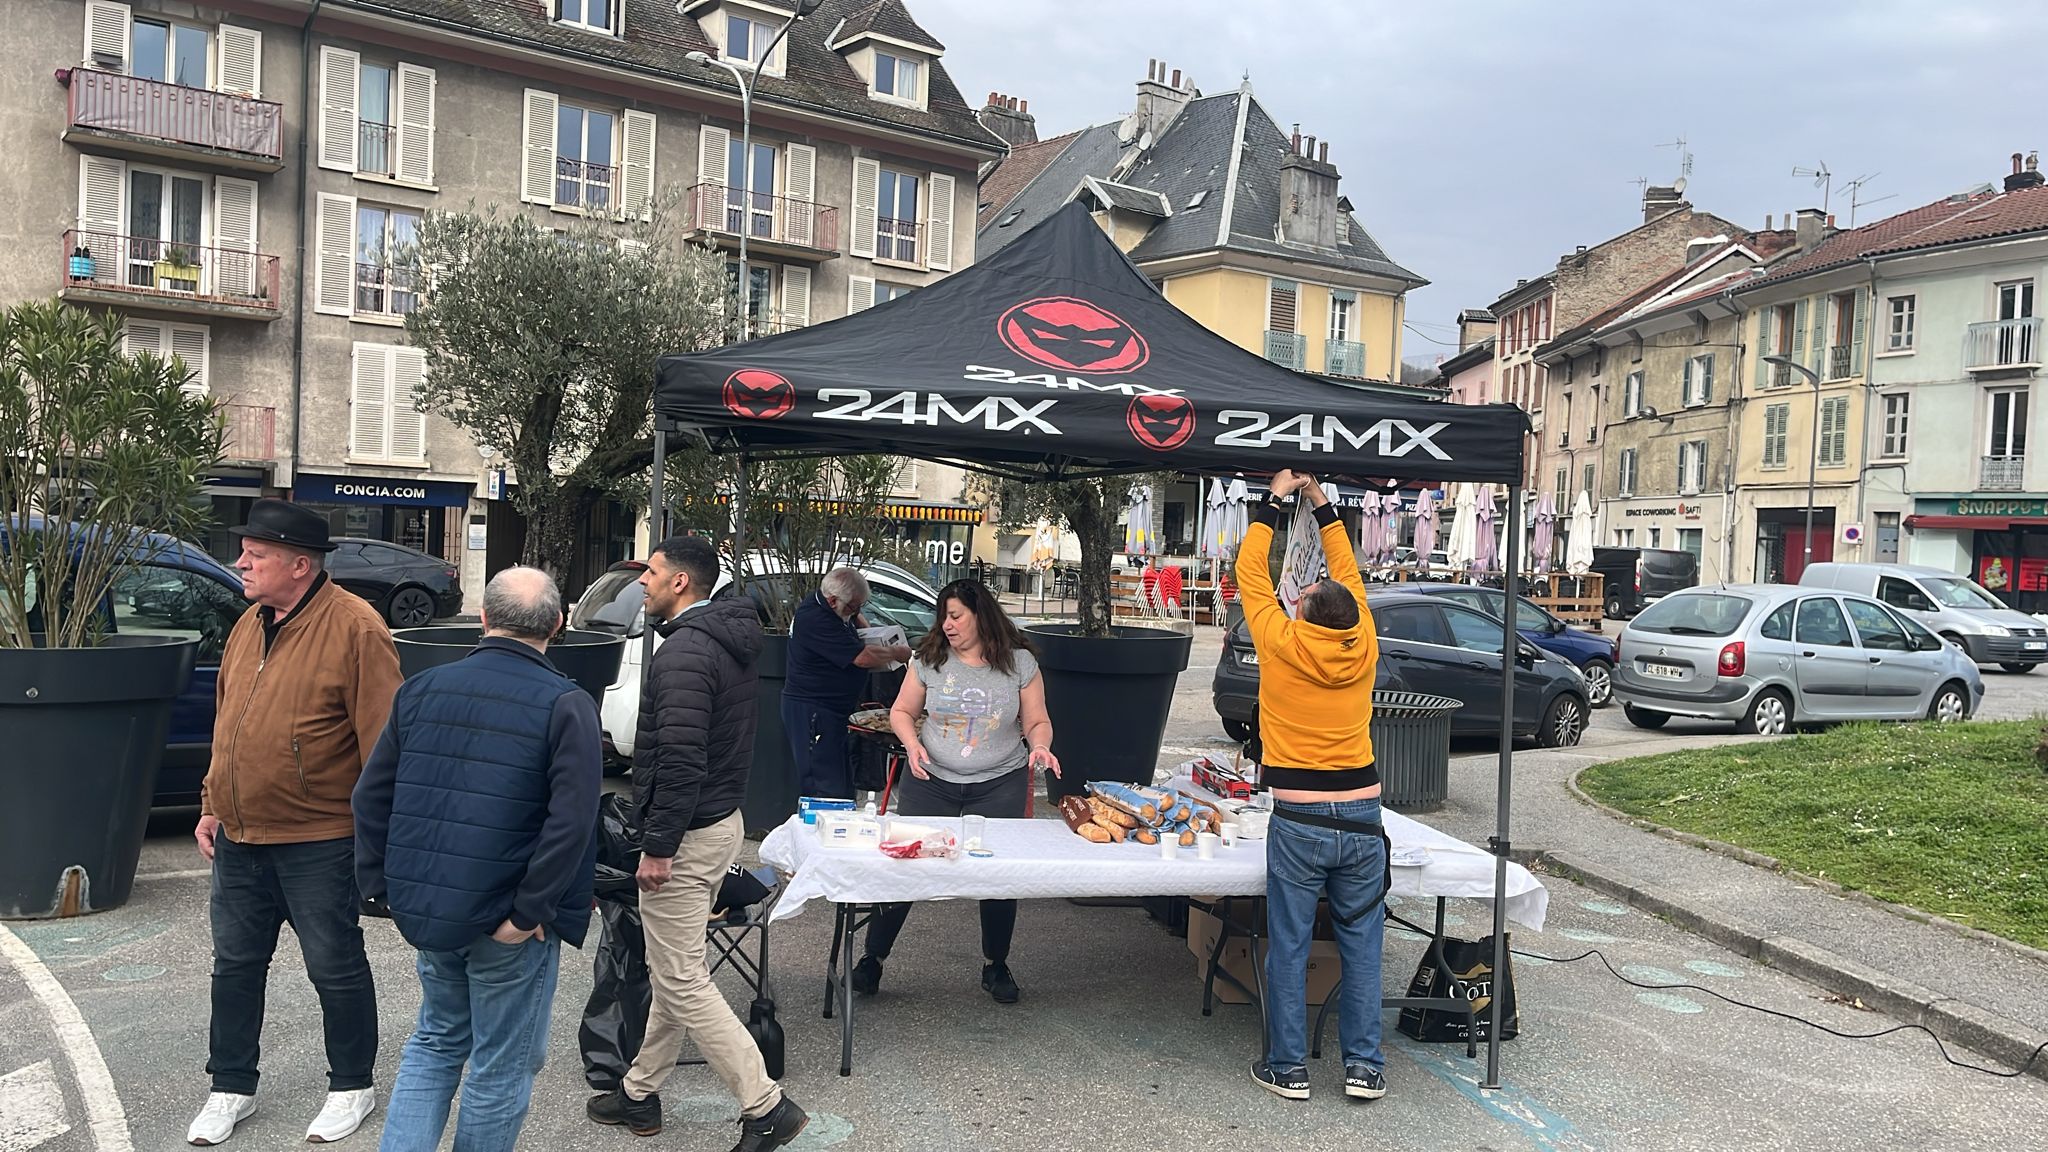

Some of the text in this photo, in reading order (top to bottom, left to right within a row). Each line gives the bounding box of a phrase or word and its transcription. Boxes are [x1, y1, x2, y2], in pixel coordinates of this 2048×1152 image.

[964, 365, 1185, 397] 24MX
[812, 388, 1063, 435] 24MX
[1214, 410, 1453, 461] 24MX
[335, 484, 425, 499] FONCIA.COM
[1348, 496, 1364, 507] RÉV
[1642, 508, 1677, 516] COWORKING
